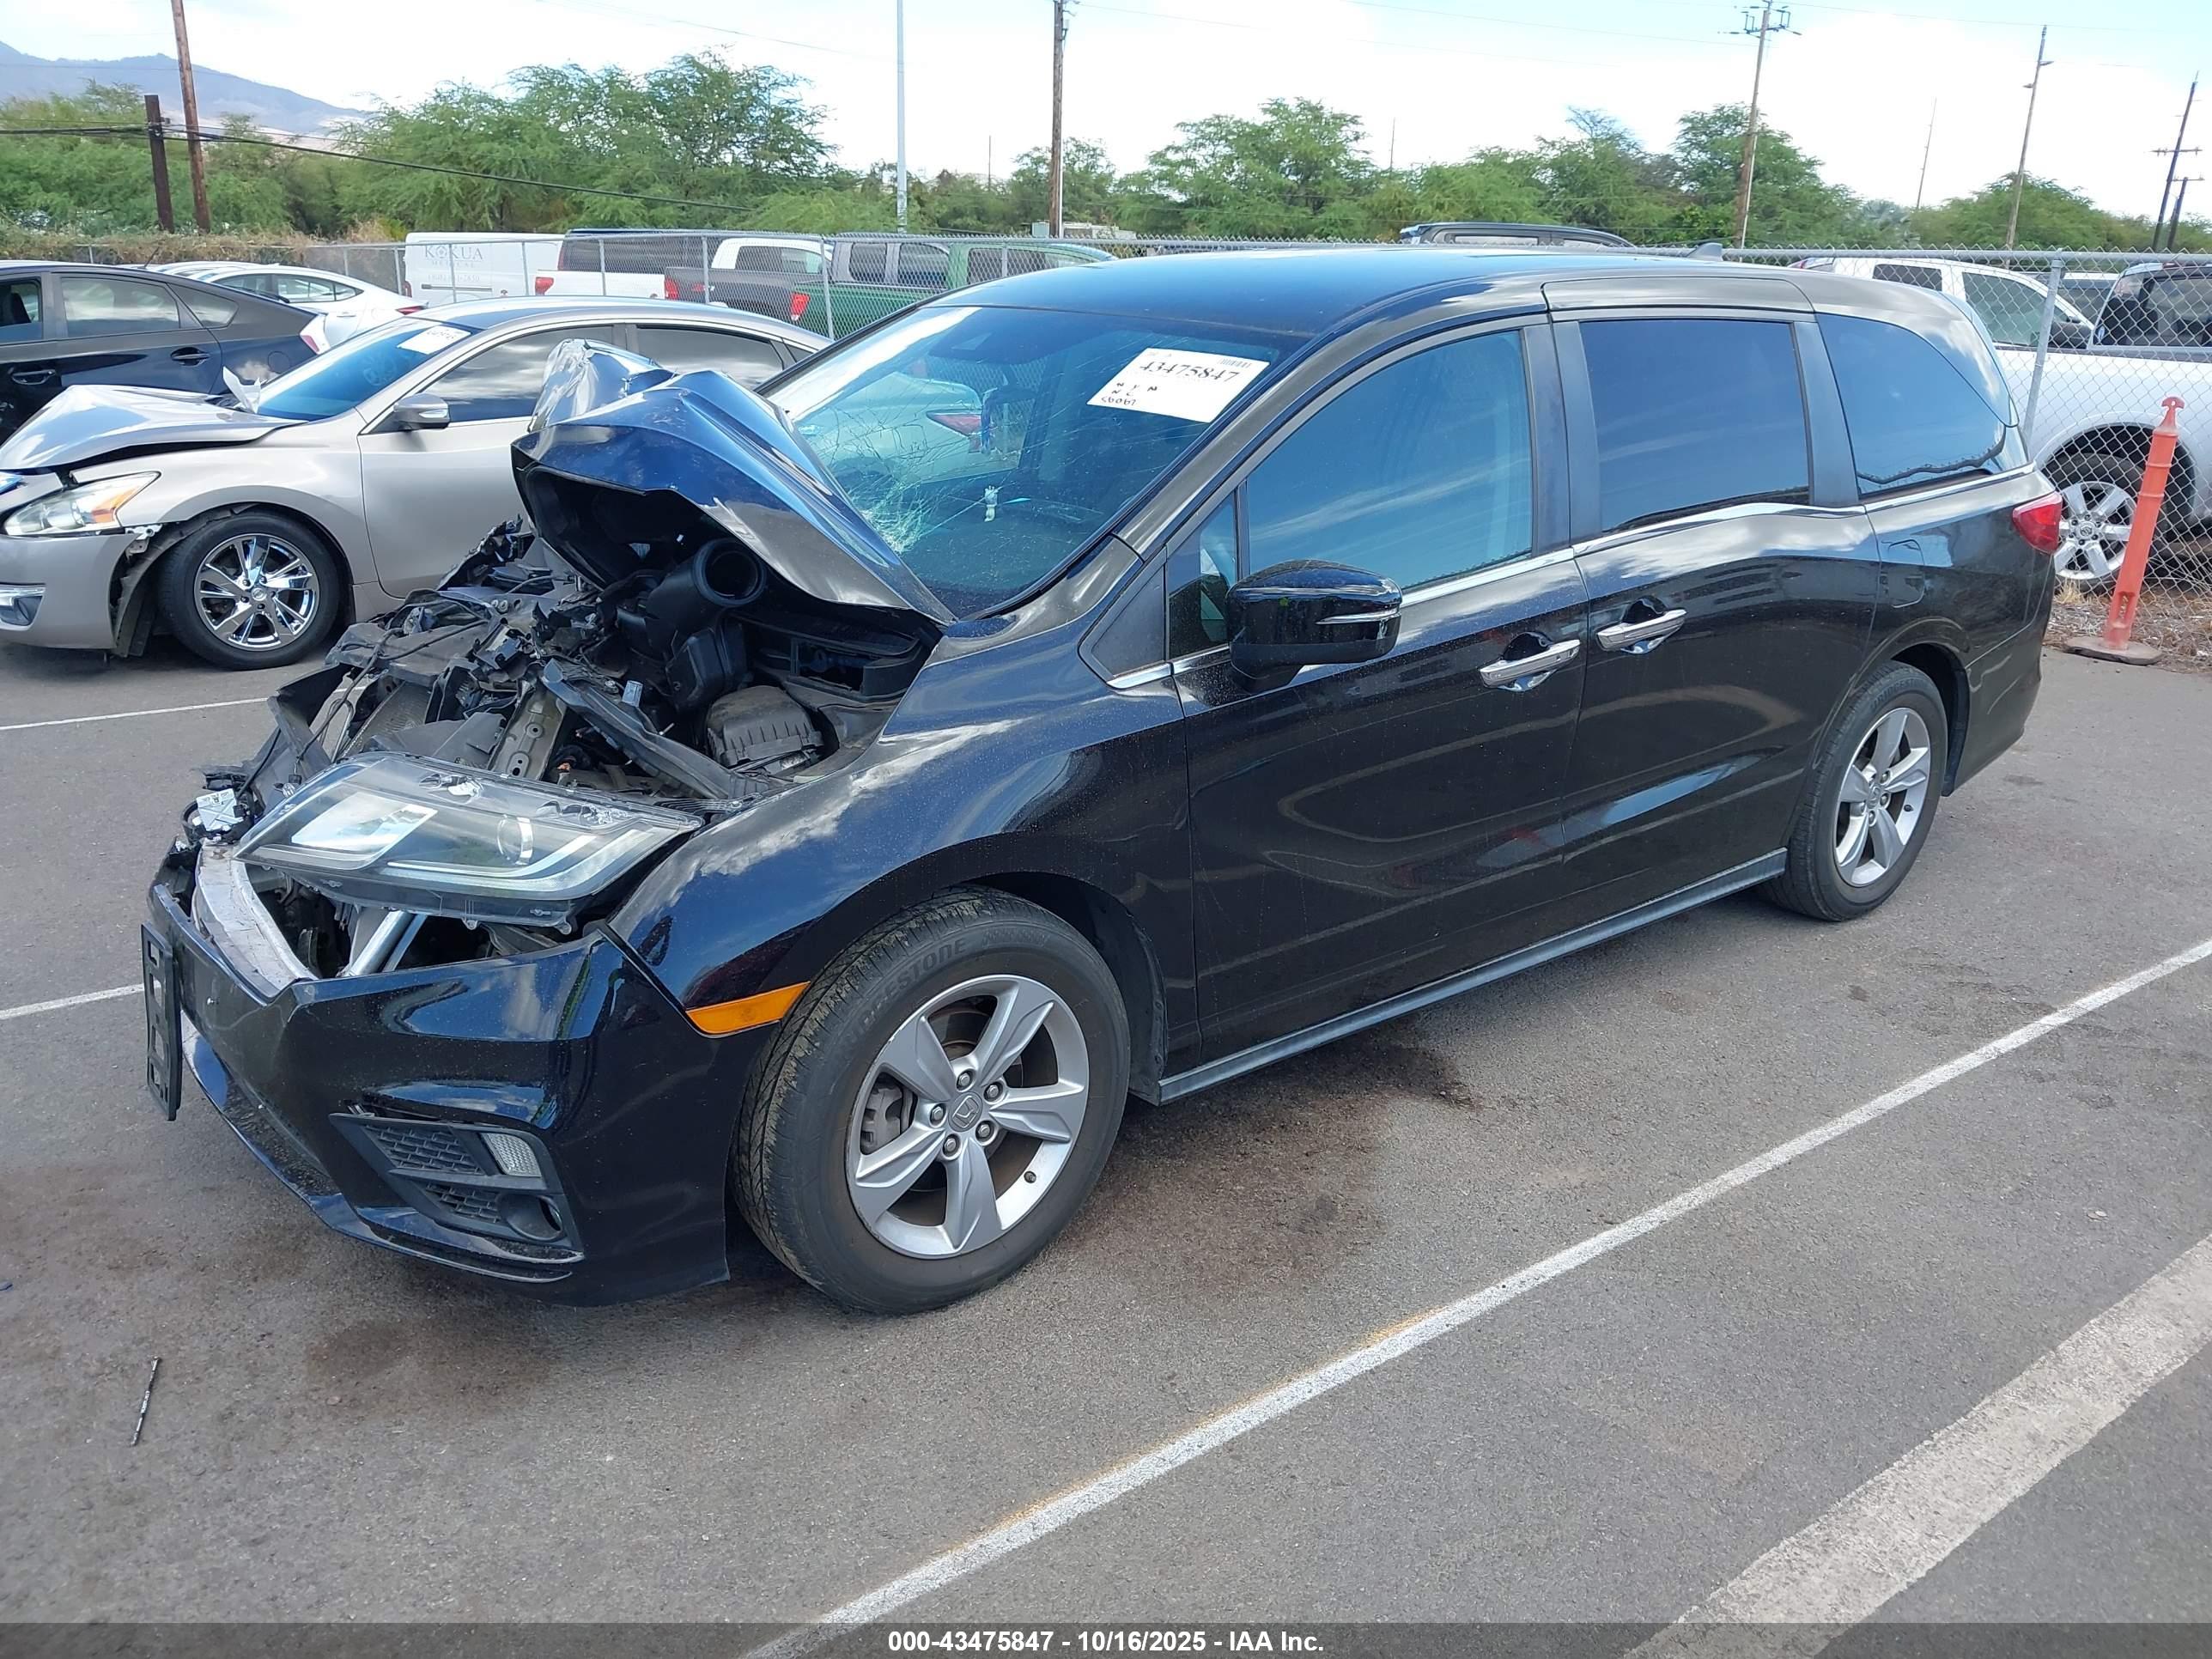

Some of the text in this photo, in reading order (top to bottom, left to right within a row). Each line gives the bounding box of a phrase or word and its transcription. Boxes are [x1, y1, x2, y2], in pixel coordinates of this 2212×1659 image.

[425, 245, 483, 259] KOKUA
[1139, 361, 1240, 382] 43475847
[842, 937, 967, 1046] DGESTONE
